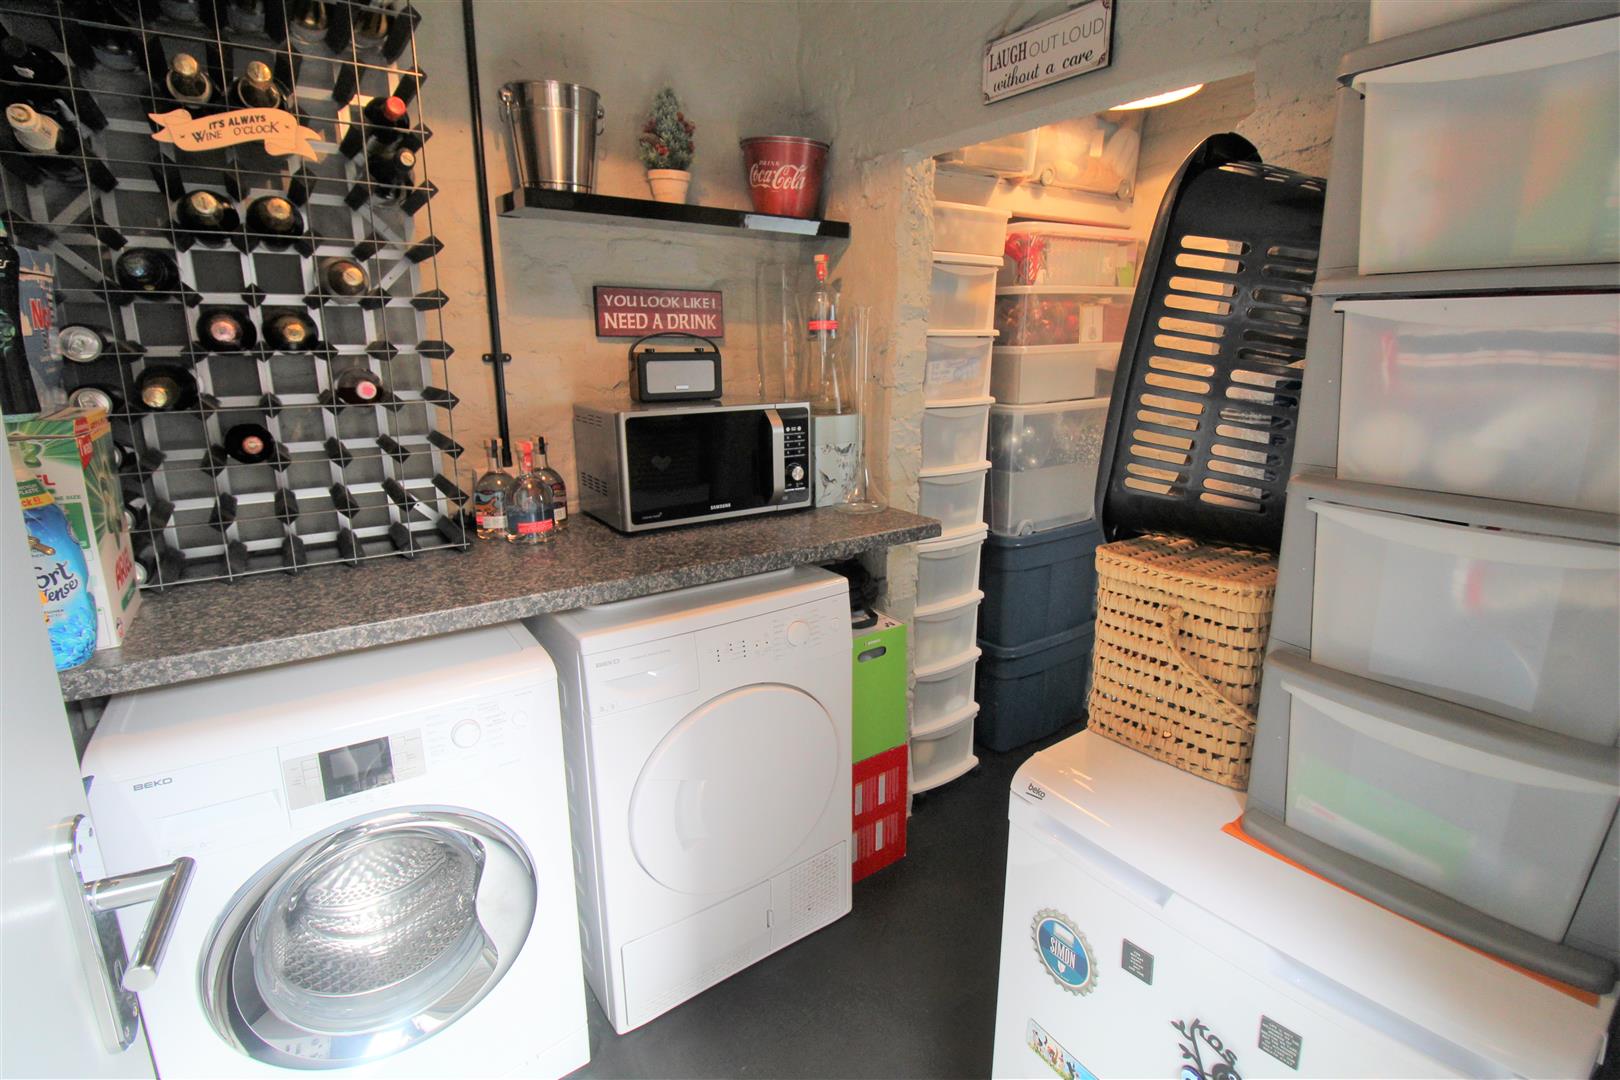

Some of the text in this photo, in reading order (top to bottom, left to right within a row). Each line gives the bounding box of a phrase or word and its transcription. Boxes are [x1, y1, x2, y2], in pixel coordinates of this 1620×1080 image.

[989, 18, 1104, 72] LAUGH OUT LOUD
[993, 49, 1093, 92] without a care
[208, 114, 266, 130] IT'S ALWAYS
[603, 294, 716, 309] YOU LOOK LIKE I
[604, 312, 717, 330] NEED A DRINK
[133, 777, 173, 791] BEKO
[1027, 783, 1046, 799] beko
[1048, 936, 1076, 969] SIMON
